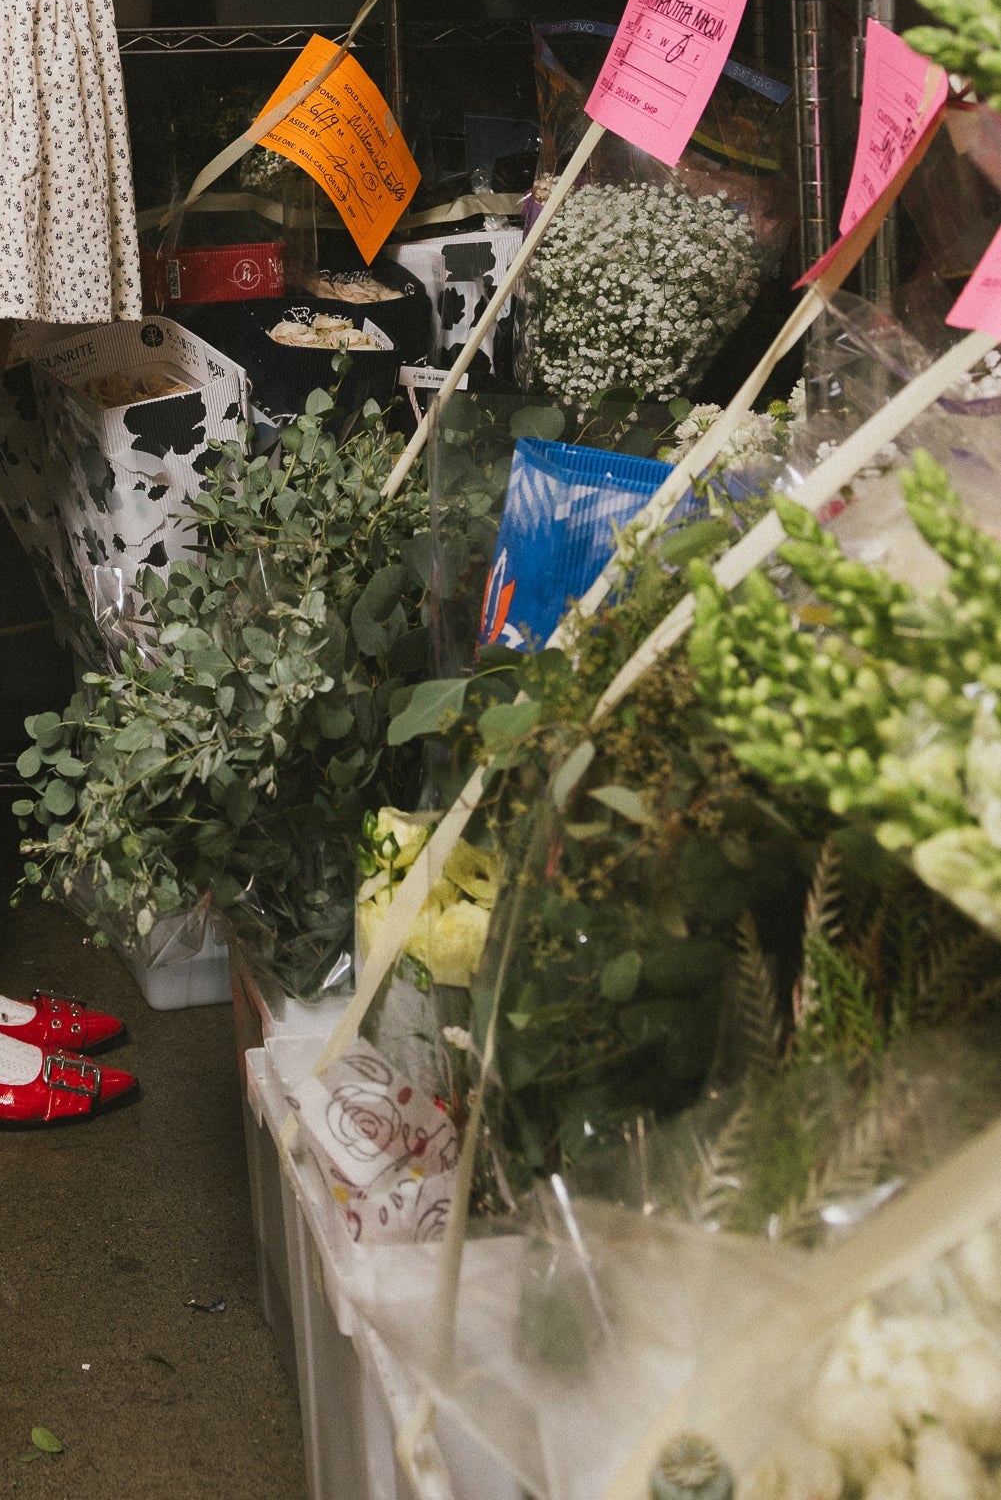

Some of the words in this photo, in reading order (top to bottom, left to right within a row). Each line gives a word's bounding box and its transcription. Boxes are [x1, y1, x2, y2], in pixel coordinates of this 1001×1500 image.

[645, 29, 653, 40] Tu
[660, 37, 670, 47] W
[694, 55, 700, 63] F
[343, 83, 359, 102] SOLD
[357, 101, 368, 114] and
[366, 111, 376, 129] SET
[374, 126, 388, 148] ASIDE!
[615, 86, 641, 106] DELIVERY
[643, 102, 658, 115] SHIP
[289, 117, 309, 132] ASIDE
[309, 128, 321, 141] BY:
[307, 102, 340, 133] 6/19
[336, 129, 345, 138] M
[349, 144, 356, 155] Tu
[359, 160, 367, 170] W
[367, 176, 376, 188] Th
[281, 138, 297, 150] ONE:
[298, 147, 327, 174] WILL-CALL
[328, 176, 348, 203] DELIVERY
[346, 205, 357, 219] SHIP
[39, 342, 96, 369] SUNRITE
